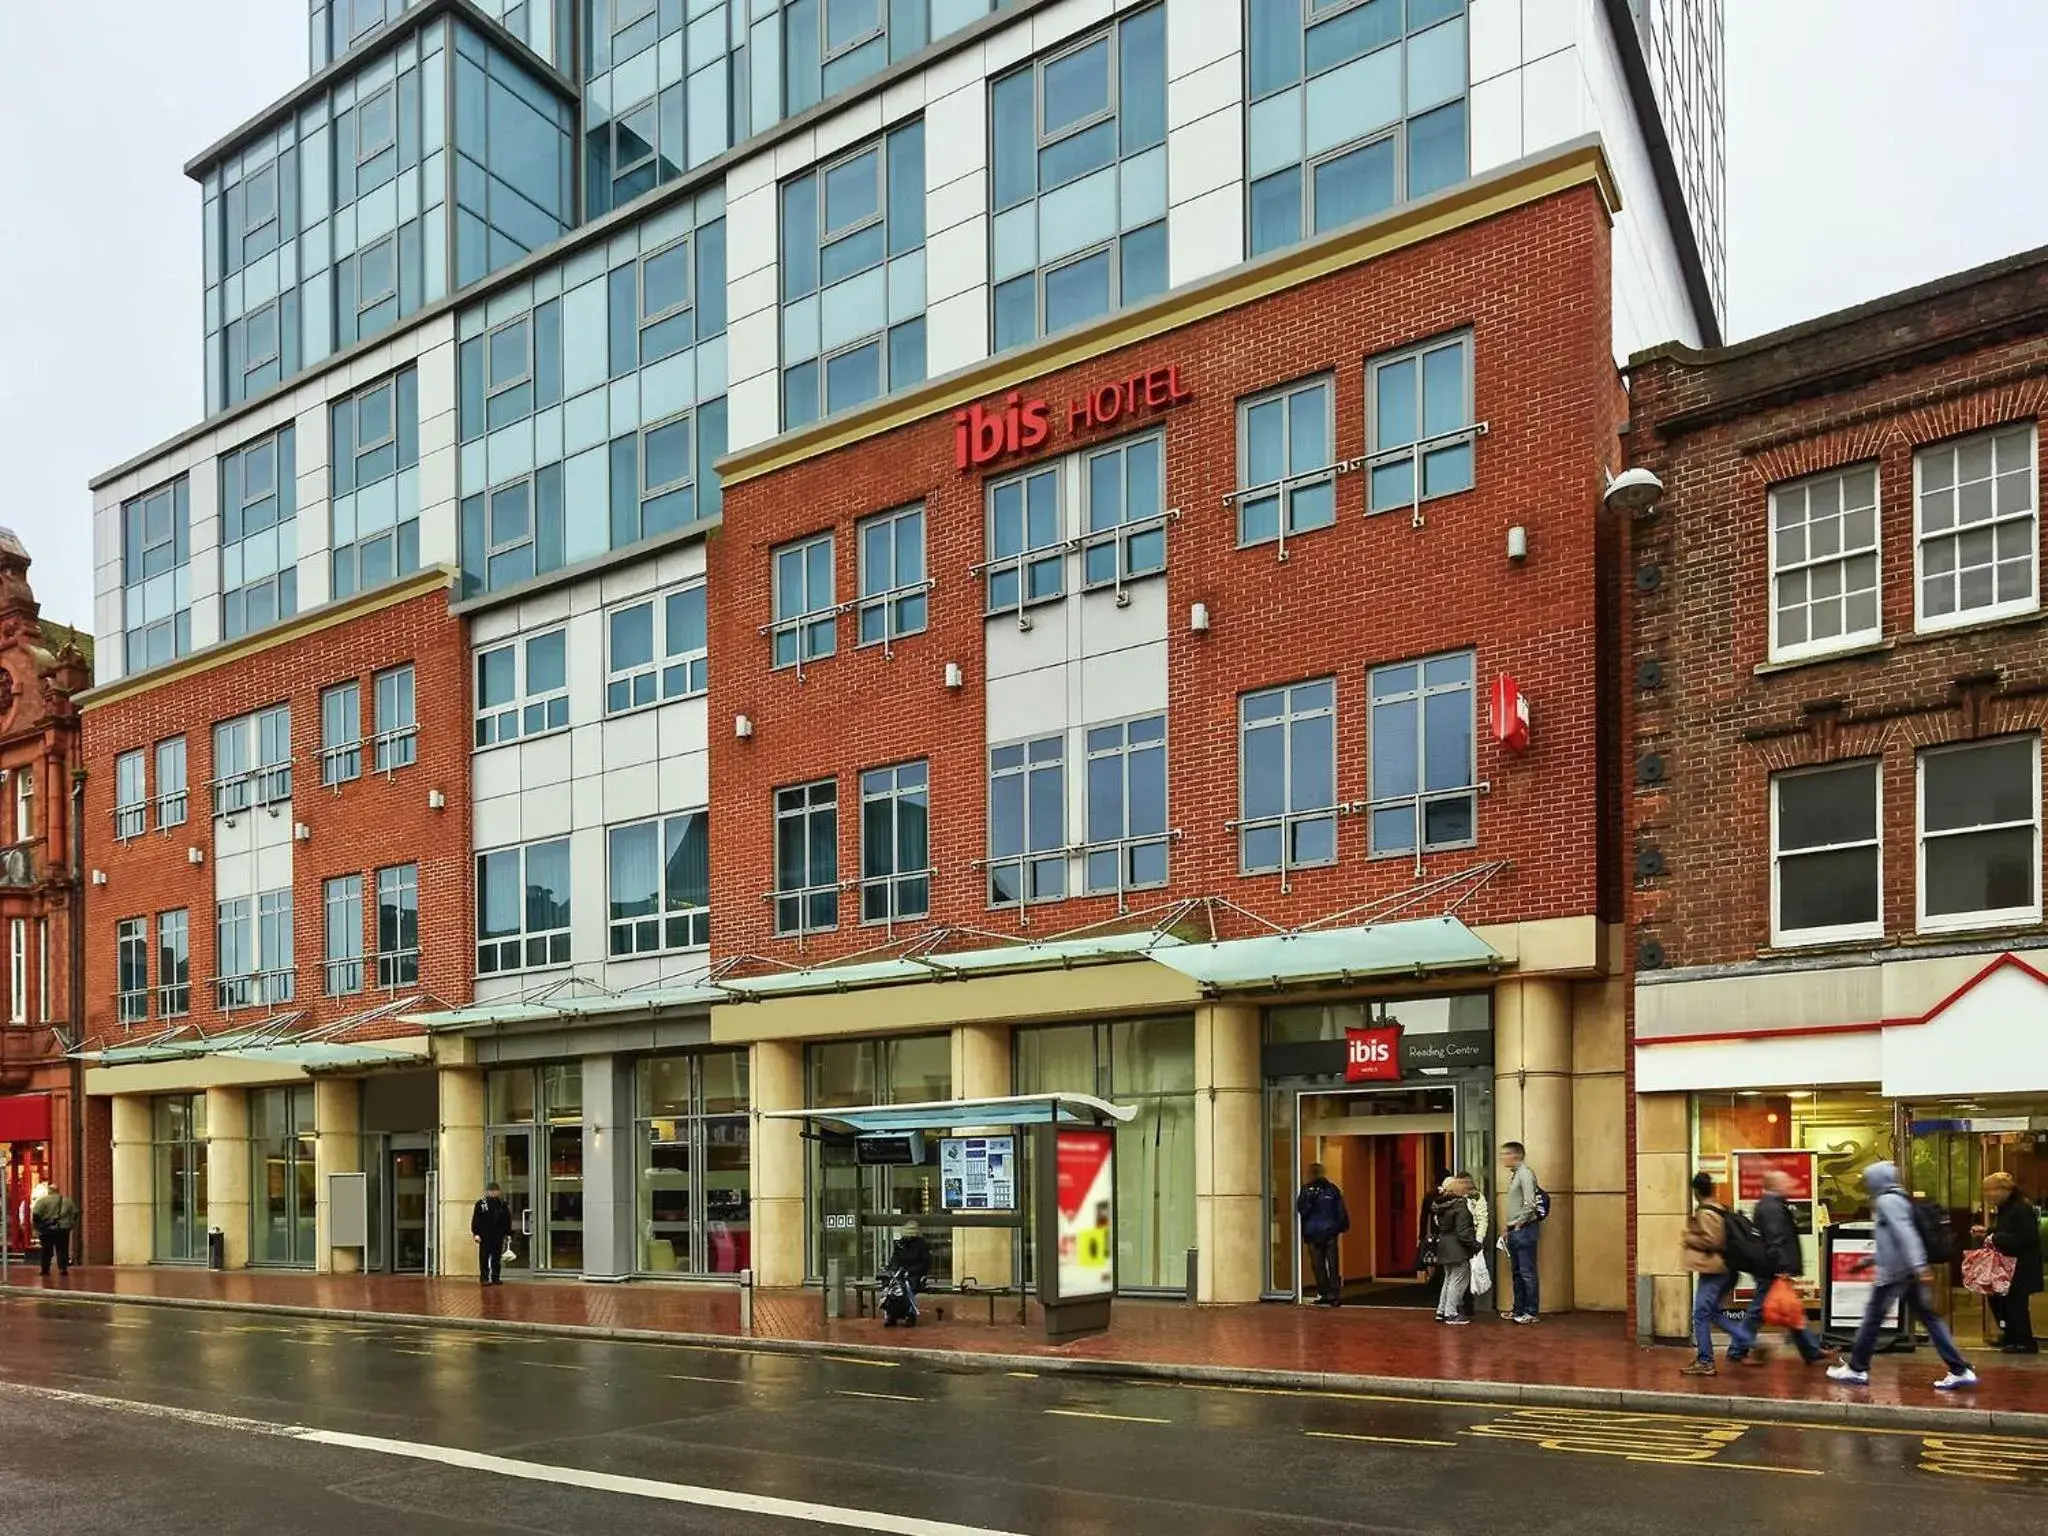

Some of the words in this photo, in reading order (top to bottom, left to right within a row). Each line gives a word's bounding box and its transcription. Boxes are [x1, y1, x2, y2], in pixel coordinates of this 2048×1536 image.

[954, 392, 1050, 470] ibis
[1067, 362, 1194, 433] HOTEL
[1349, 1038, 1390, 1063] ibis
[1408, 1044, 1445, 1059] Reading
